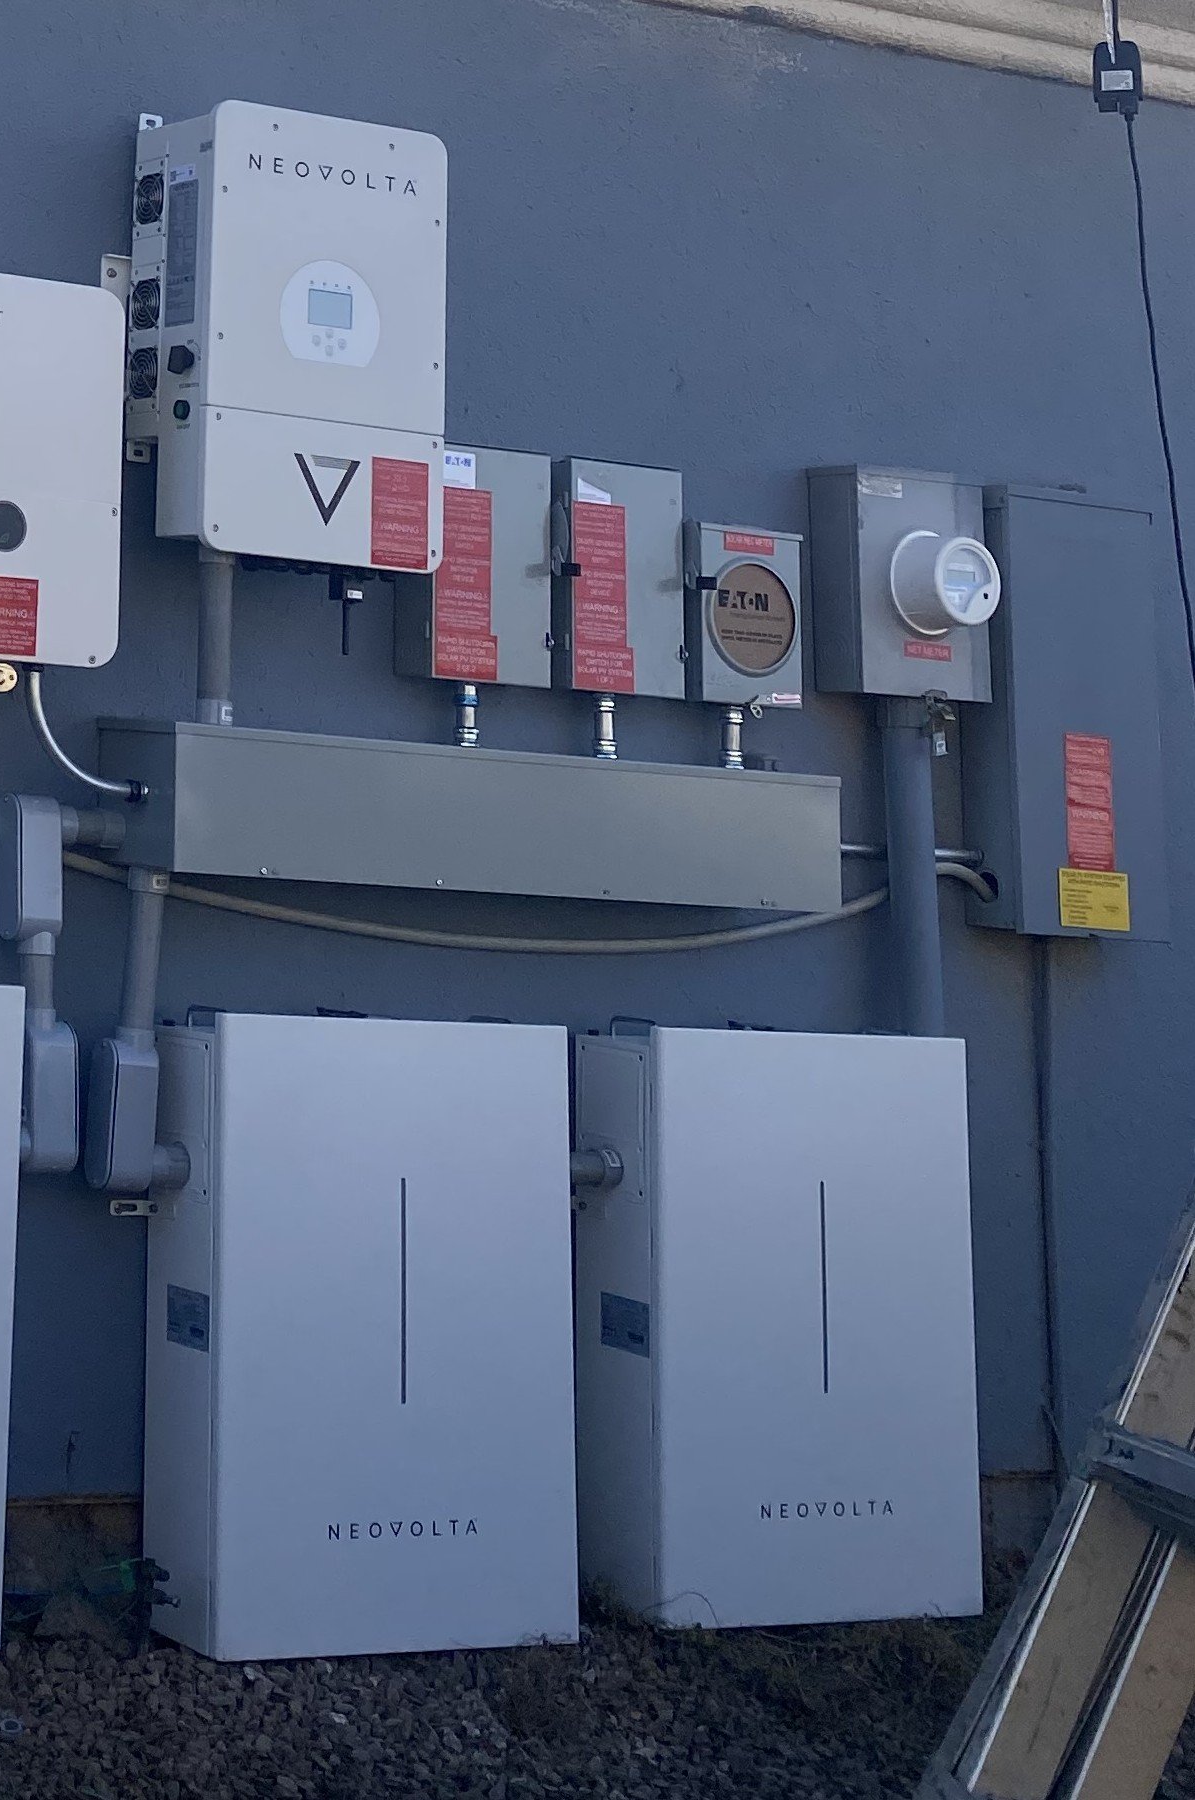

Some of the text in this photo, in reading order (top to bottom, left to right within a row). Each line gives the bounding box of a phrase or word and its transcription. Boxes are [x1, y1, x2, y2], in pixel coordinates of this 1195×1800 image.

[248, 153, 417, 197] NEOVOLTA
[444, 589, 483, 600] WARNING
[718, 589, 769, 612] EATON
[582, 603, 619, 614] WARNING
[923, 646, 949, 658] METER
[760, 1500, 894, 1519] NEOVOLTA
[328, 1519, 478, 1540] NEOVOLTA
